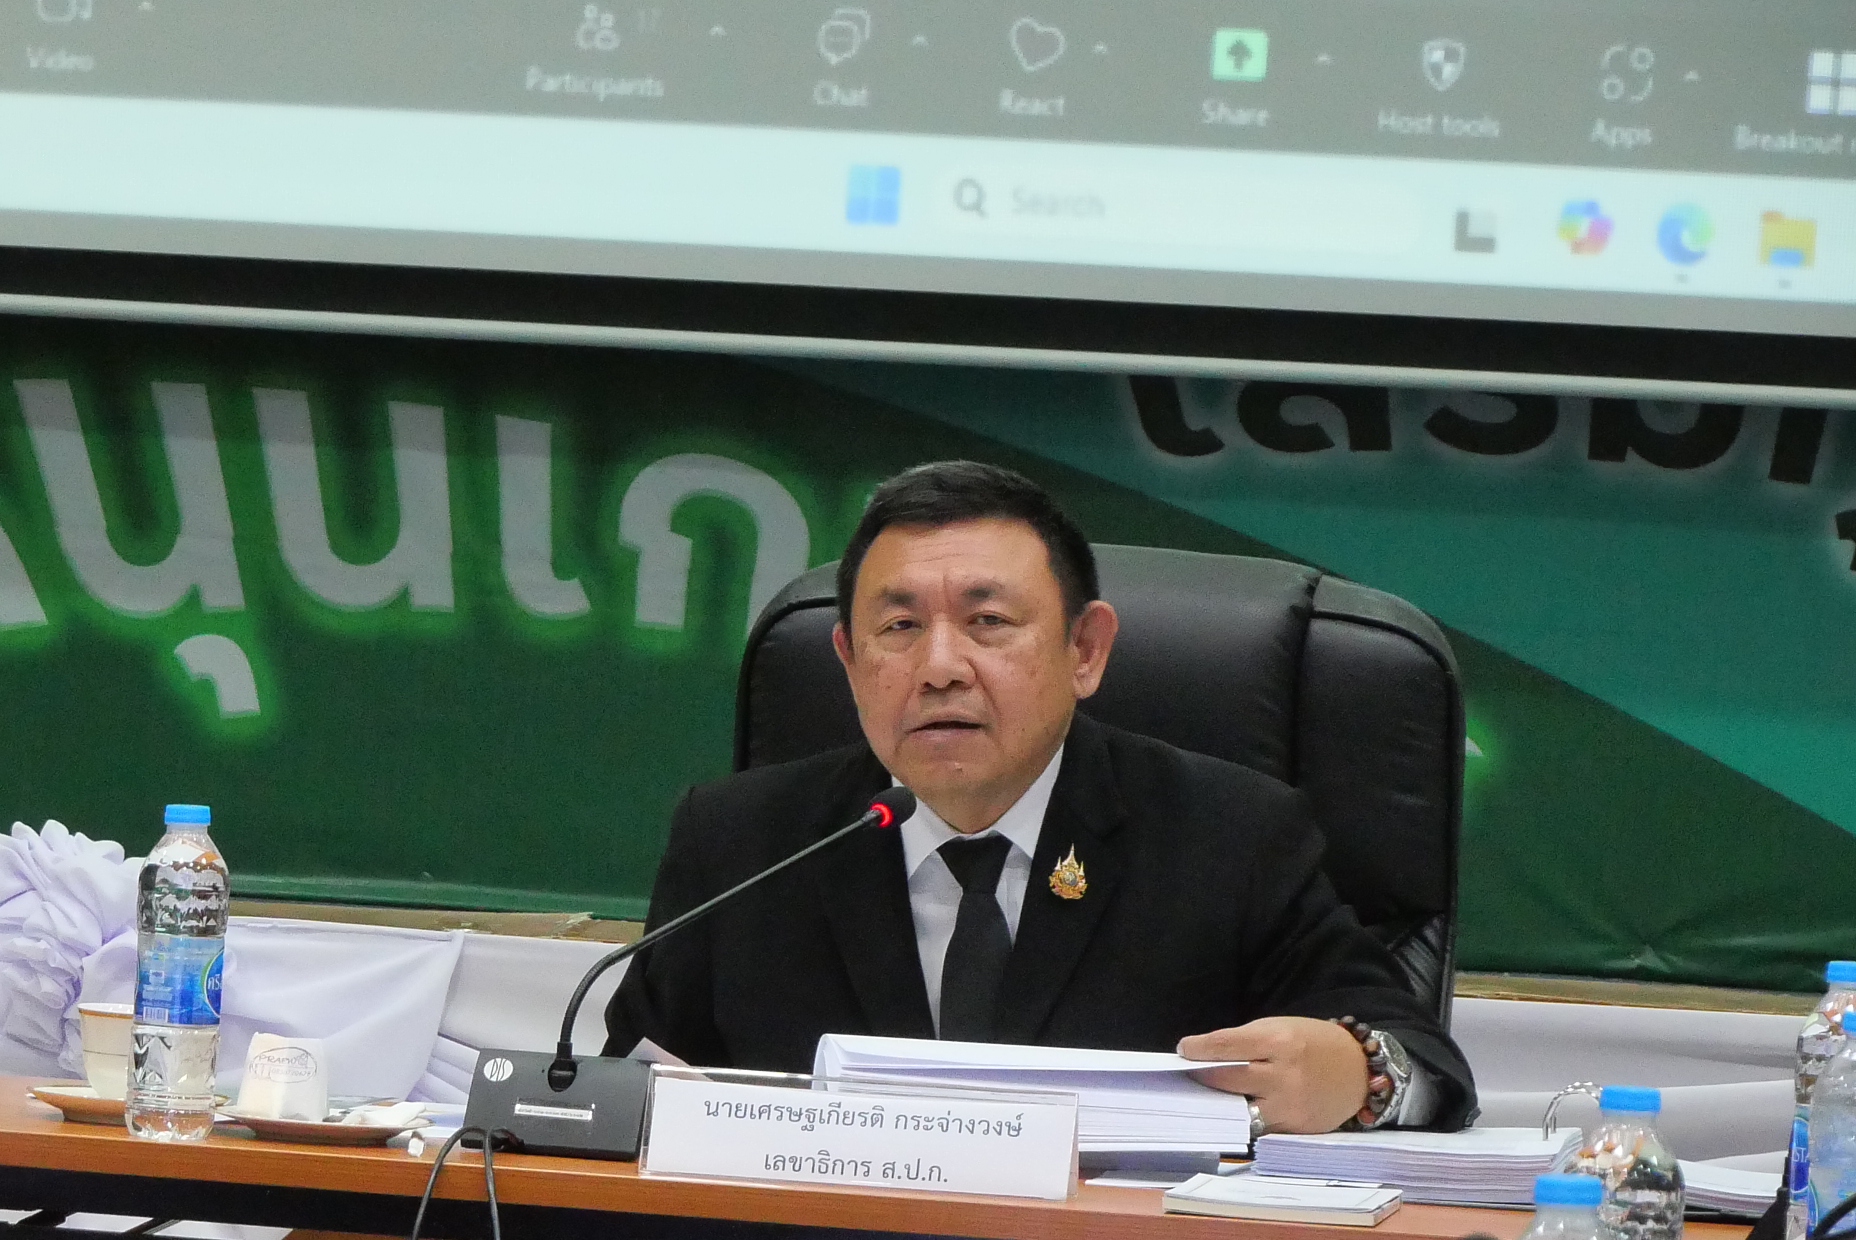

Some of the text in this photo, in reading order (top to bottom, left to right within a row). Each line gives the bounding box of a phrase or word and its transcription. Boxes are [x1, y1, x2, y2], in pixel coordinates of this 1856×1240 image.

[26, 46, 94, 72] Video
[526, 65, 664, 100] Participants
[812, 79, 869, 107] Chat
[999, 88, 1065, 116] React
[1202, 98, 1269, 128] Share
[1377, 109, 1500, 139] Host tools
[1591, 119, 1652, 149] Apps
[1734, 124, 1844, 155] Breakout
[1011, 186, 1105, 219] Search
[704, 1097, 1024, 1139] นายเศรษฐเกียรติ กระจ่างวงษ์
[763, 1149, 948, 1184] เลขาธิการ ส.ป.ก.
